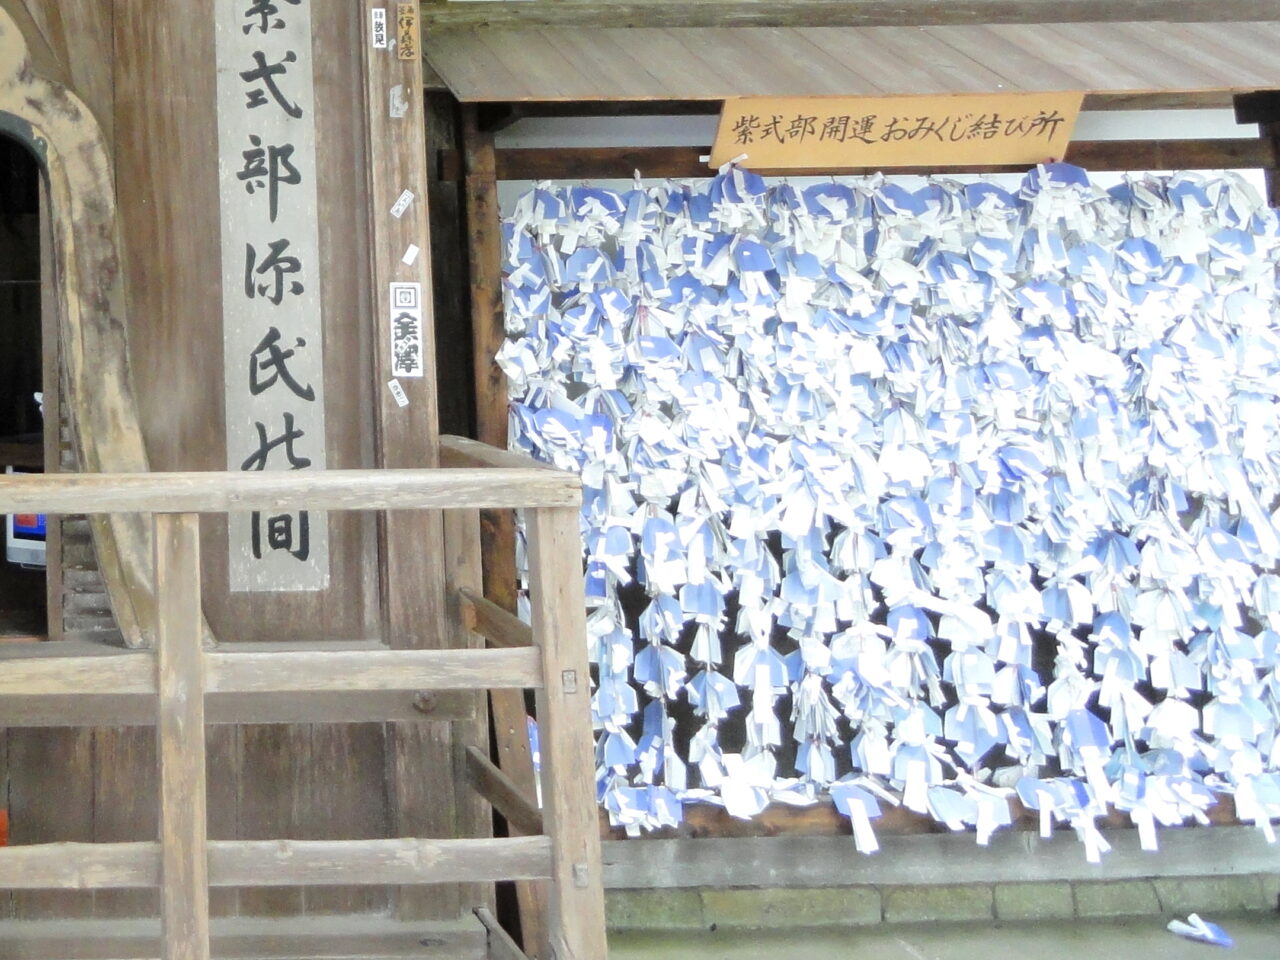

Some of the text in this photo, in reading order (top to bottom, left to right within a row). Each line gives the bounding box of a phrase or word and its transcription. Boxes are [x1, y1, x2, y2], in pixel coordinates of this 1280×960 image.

[731, 109, 1065, 145] 紫式部開運おみくじ結び所
